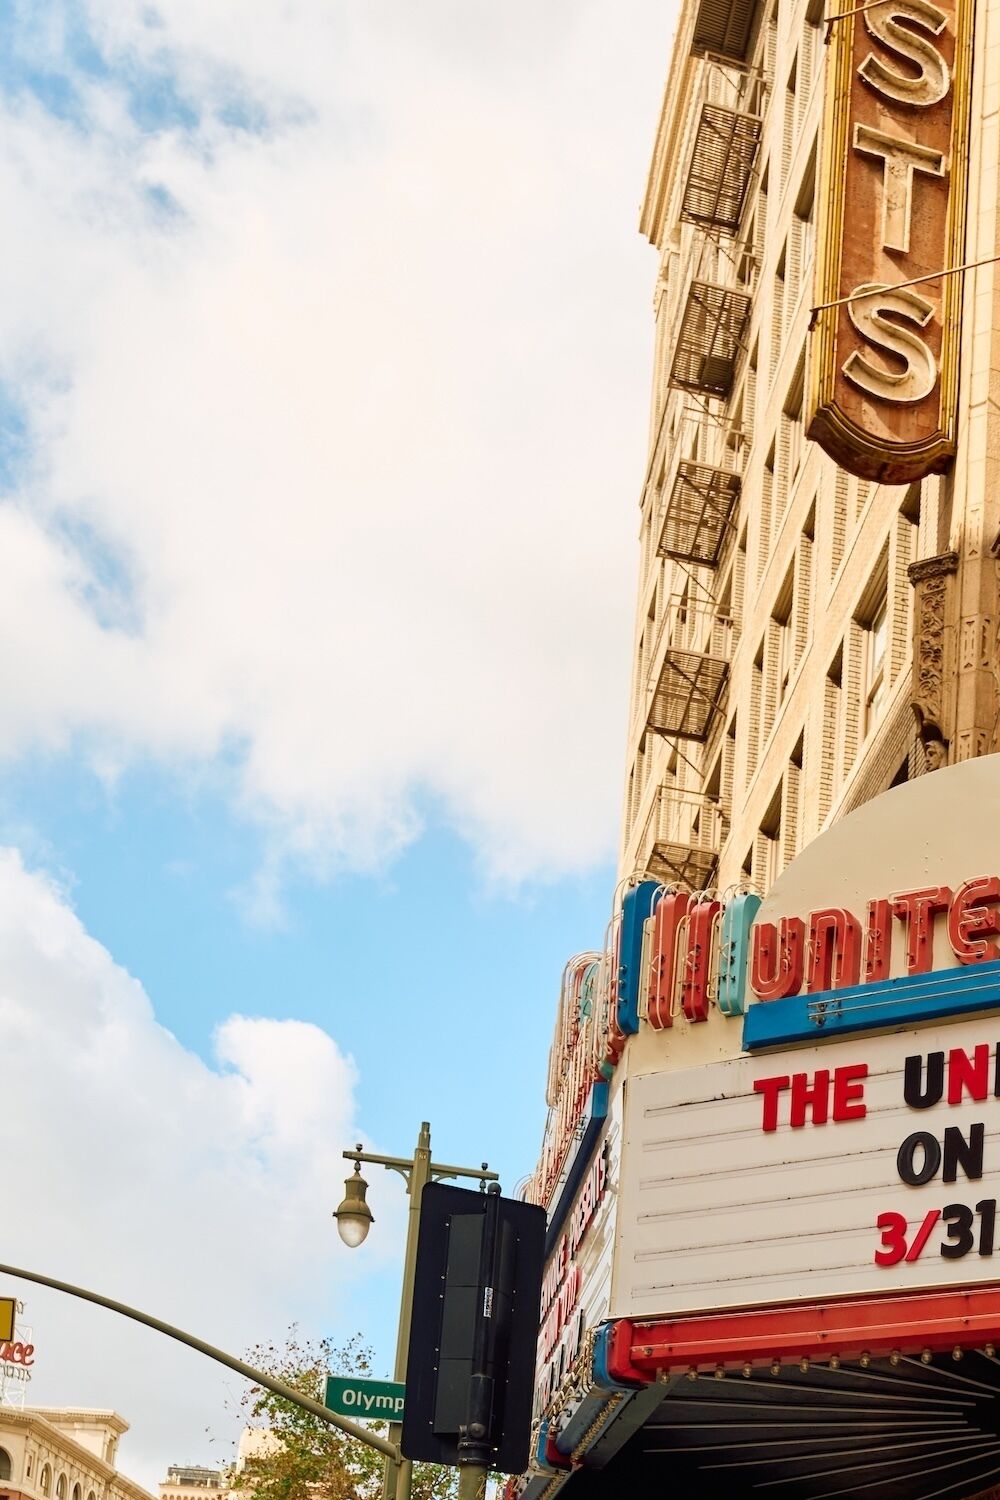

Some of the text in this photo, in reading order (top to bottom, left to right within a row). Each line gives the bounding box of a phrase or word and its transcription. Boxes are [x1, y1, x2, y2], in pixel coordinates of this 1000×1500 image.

[753, 1063, 869, 1132] THE
[897, 1122, 985, 1187] ON
[874, 1199, 997, 1267] 3/31
[342, 1389, 405, 1413] Olymp
